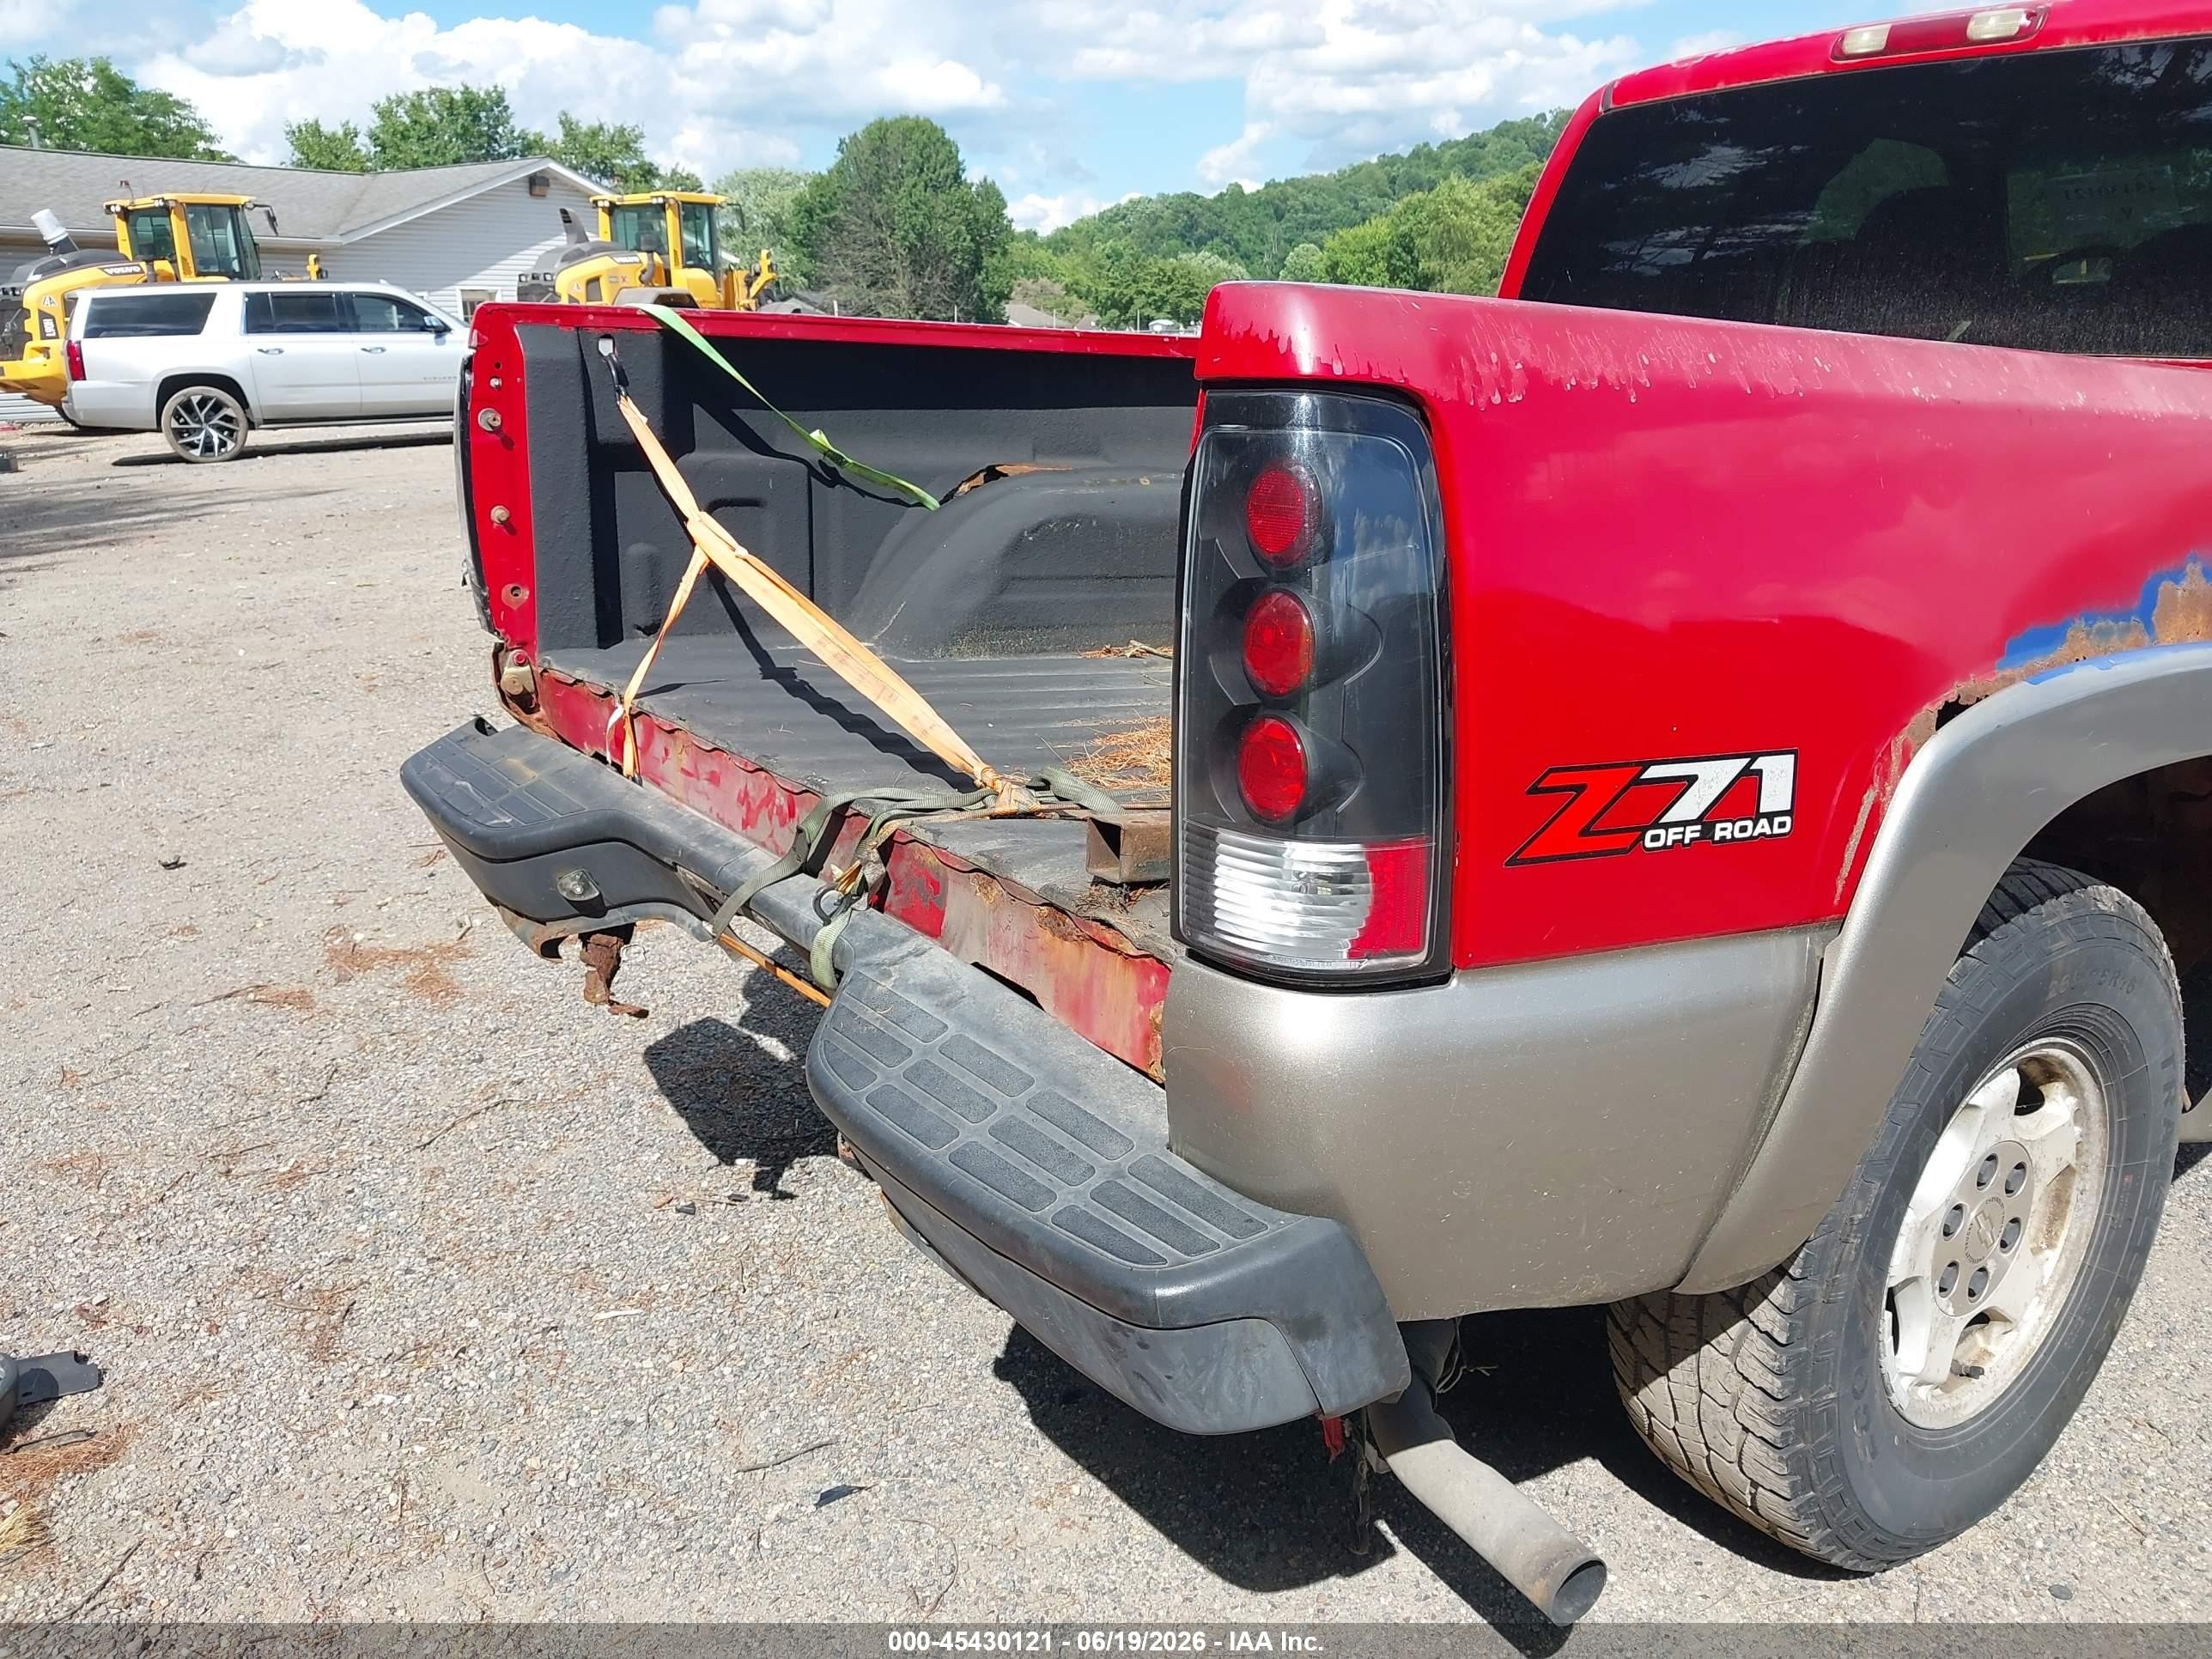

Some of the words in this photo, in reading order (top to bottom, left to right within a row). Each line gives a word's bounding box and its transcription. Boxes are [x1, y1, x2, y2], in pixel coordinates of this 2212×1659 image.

[104, 265, 141, 275] VOLVO
[1505, 749, 1798, 866] Z71
[1644, 824, 1701, 848] OFF
[1714, 817, 1792, 841] ROAD
